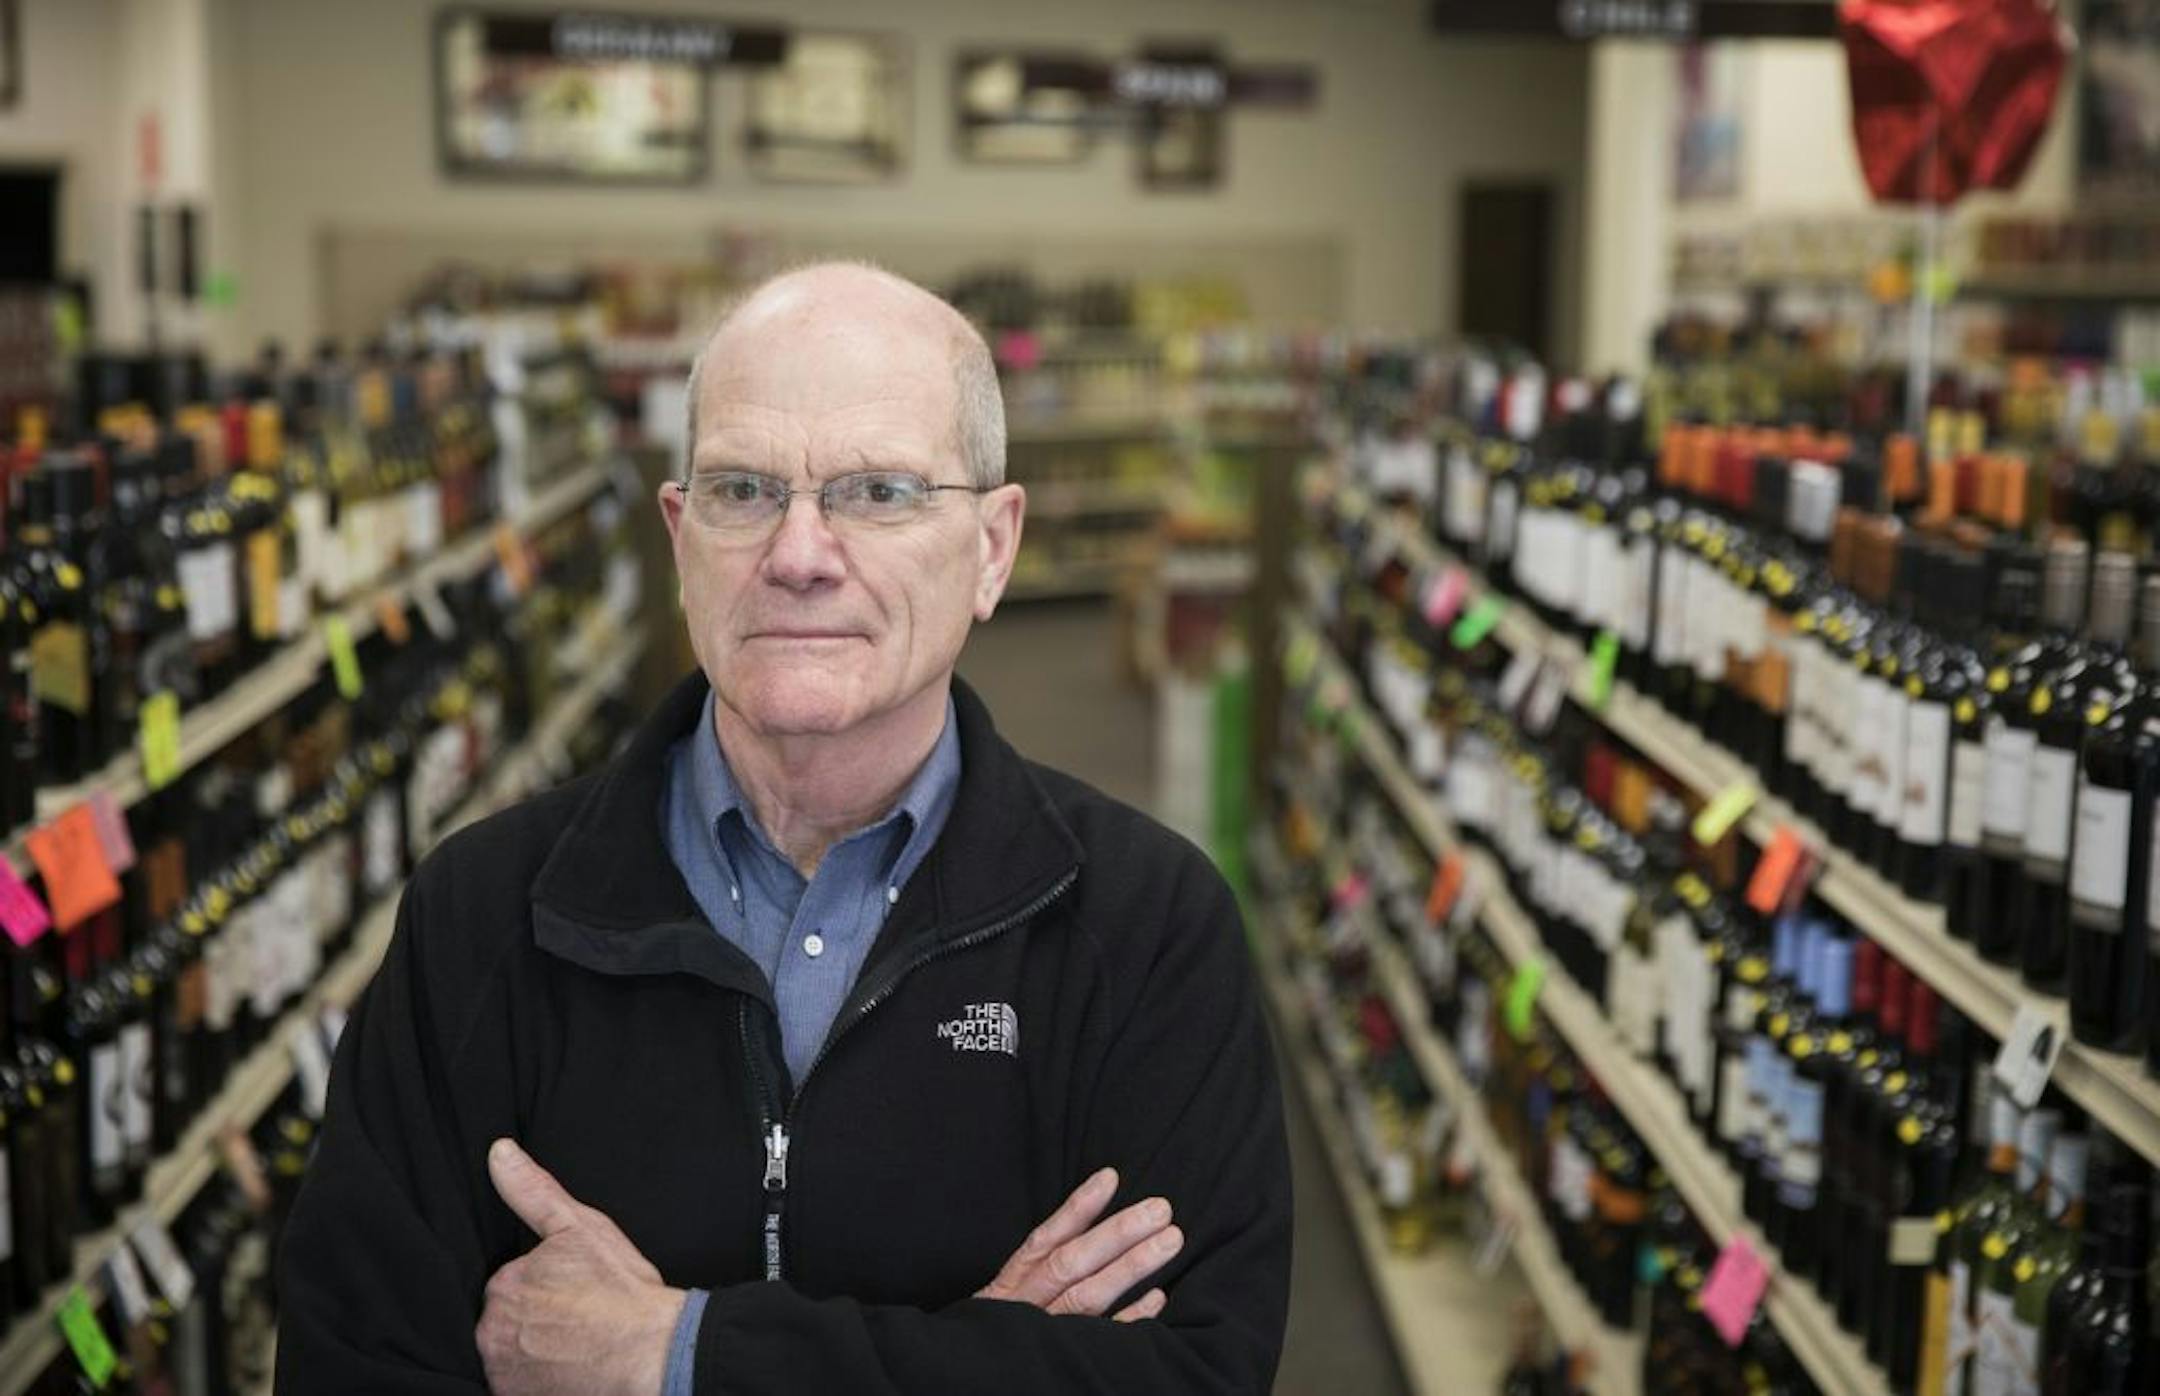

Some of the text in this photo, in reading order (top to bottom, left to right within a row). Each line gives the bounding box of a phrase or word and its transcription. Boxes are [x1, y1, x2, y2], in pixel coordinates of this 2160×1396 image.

[964, 1002, 1001, 1019] THE
[937, 1019, 1001, 1038] NORTH
[952, 1035, 1001, 1052] FACE
